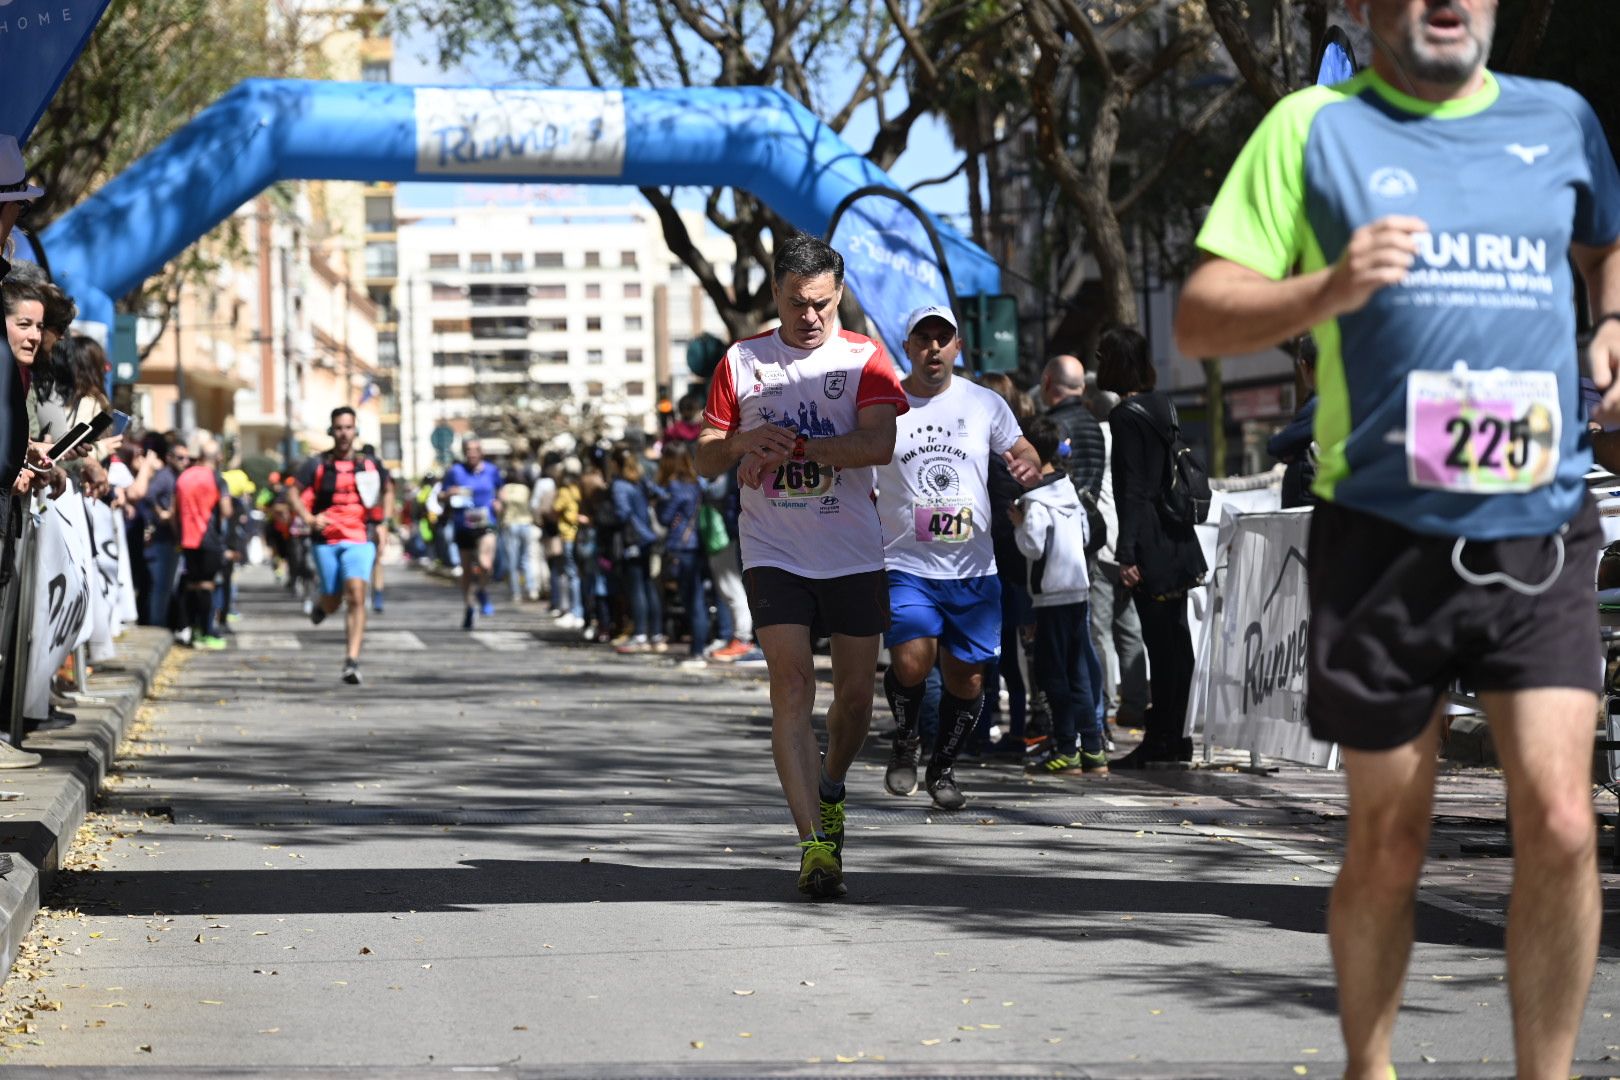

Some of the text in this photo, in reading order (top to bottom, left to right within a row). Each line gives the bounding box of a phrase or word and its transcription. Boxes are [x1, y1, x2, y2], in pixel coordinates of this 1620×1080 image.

[1476, 233, 1547, 274] RUN
[900, 444, 968, 465] 10K NOCTURN
[1444, 415, 1531, 470] 225
[772, 460, 821, 490] 269
[777, 500, 808, 509] cajamar
[928, 513, 962, 536] 421
[1242, 619, 1308, 716] Runne
